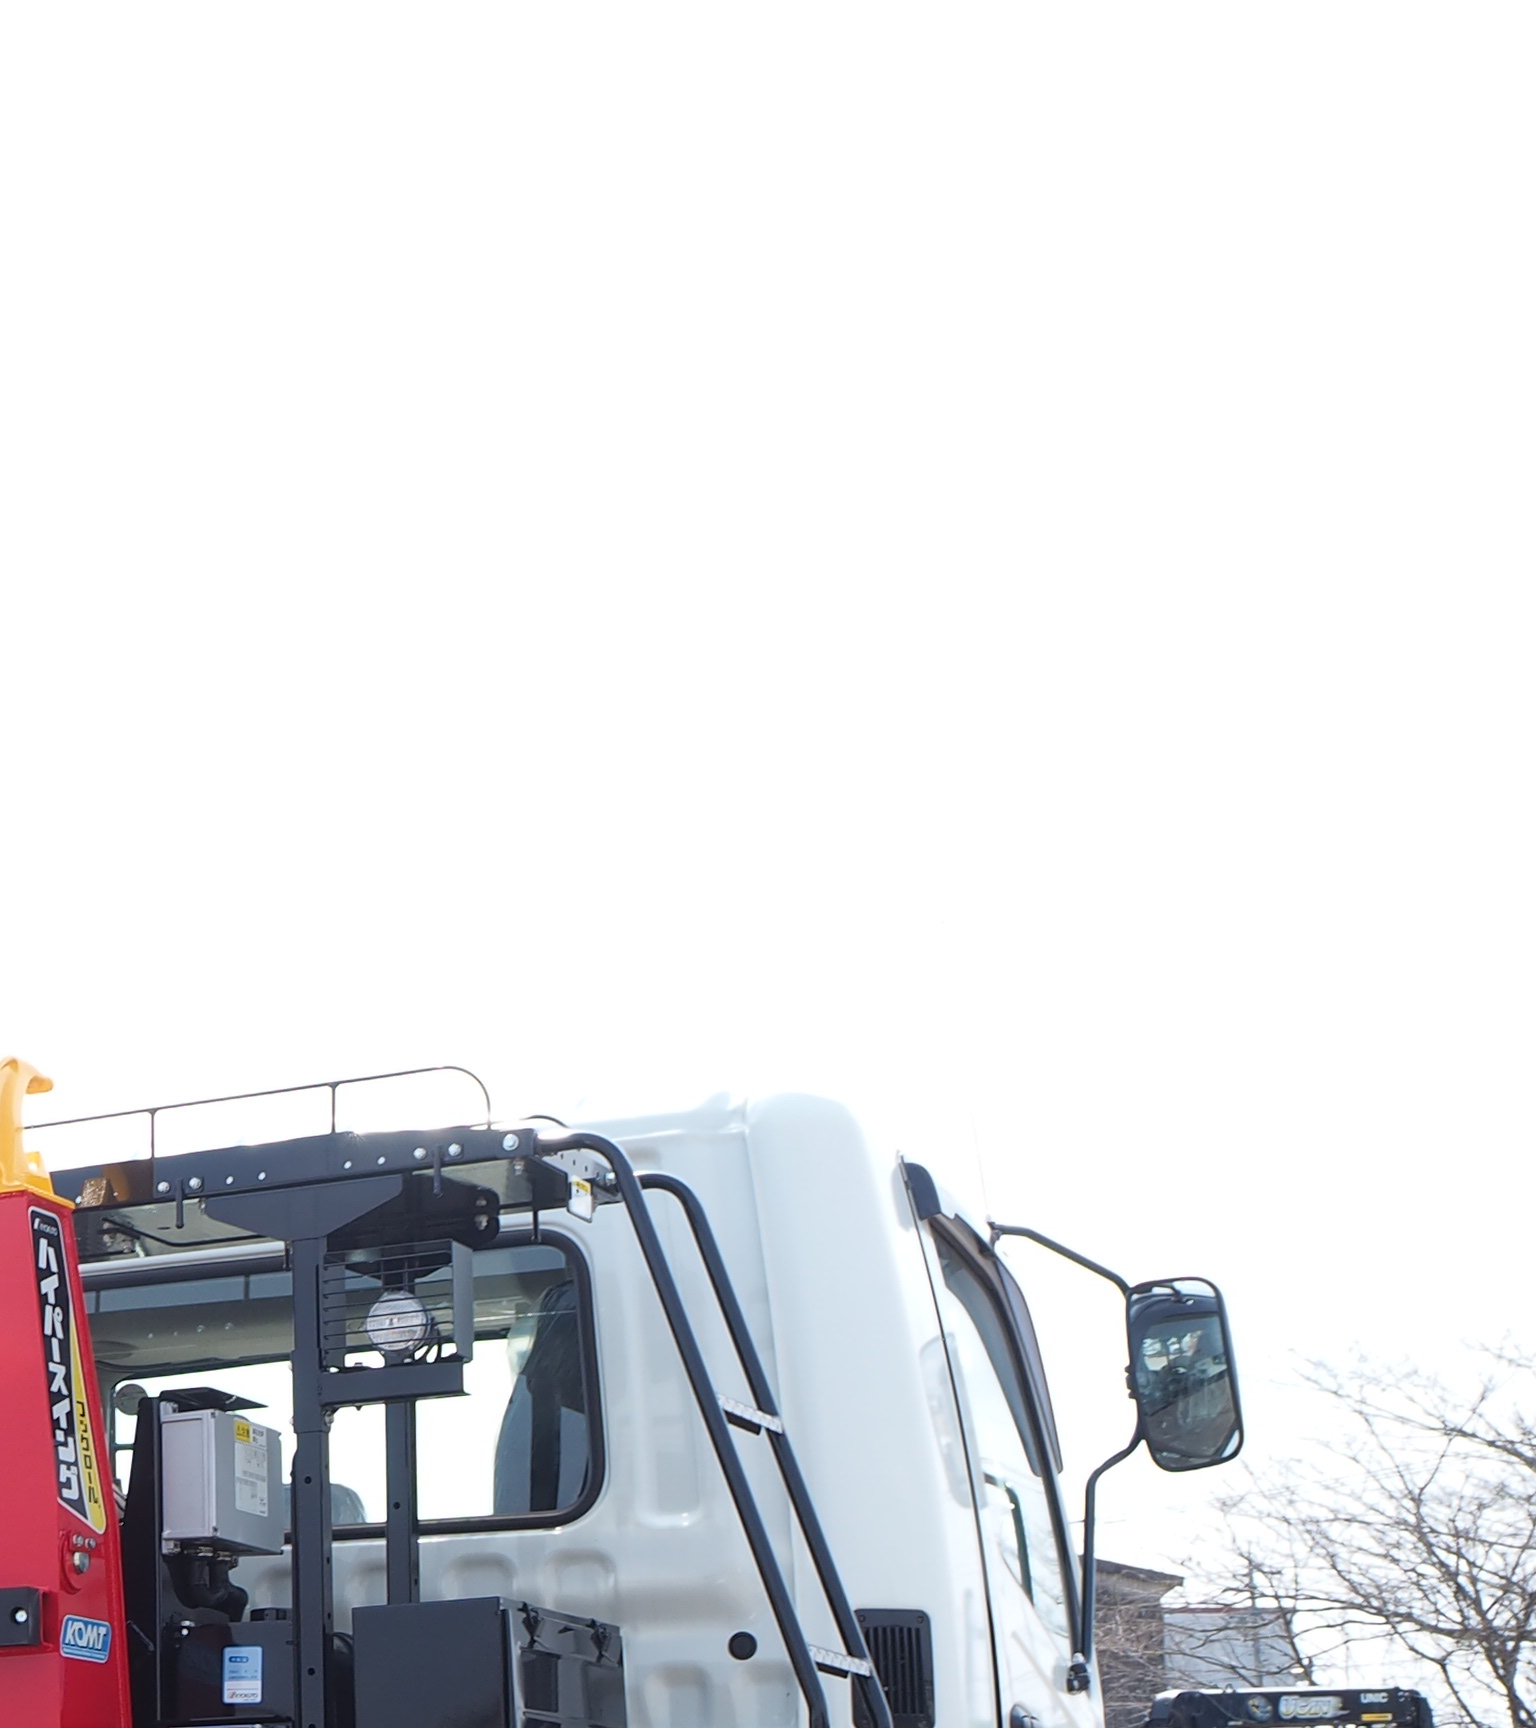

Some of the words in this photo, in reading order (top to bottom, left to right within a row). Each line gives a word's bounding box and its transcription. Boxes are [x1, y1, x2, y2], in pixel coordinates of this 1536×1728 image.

[38, 1237, 80, 1500] ハイパースイング
